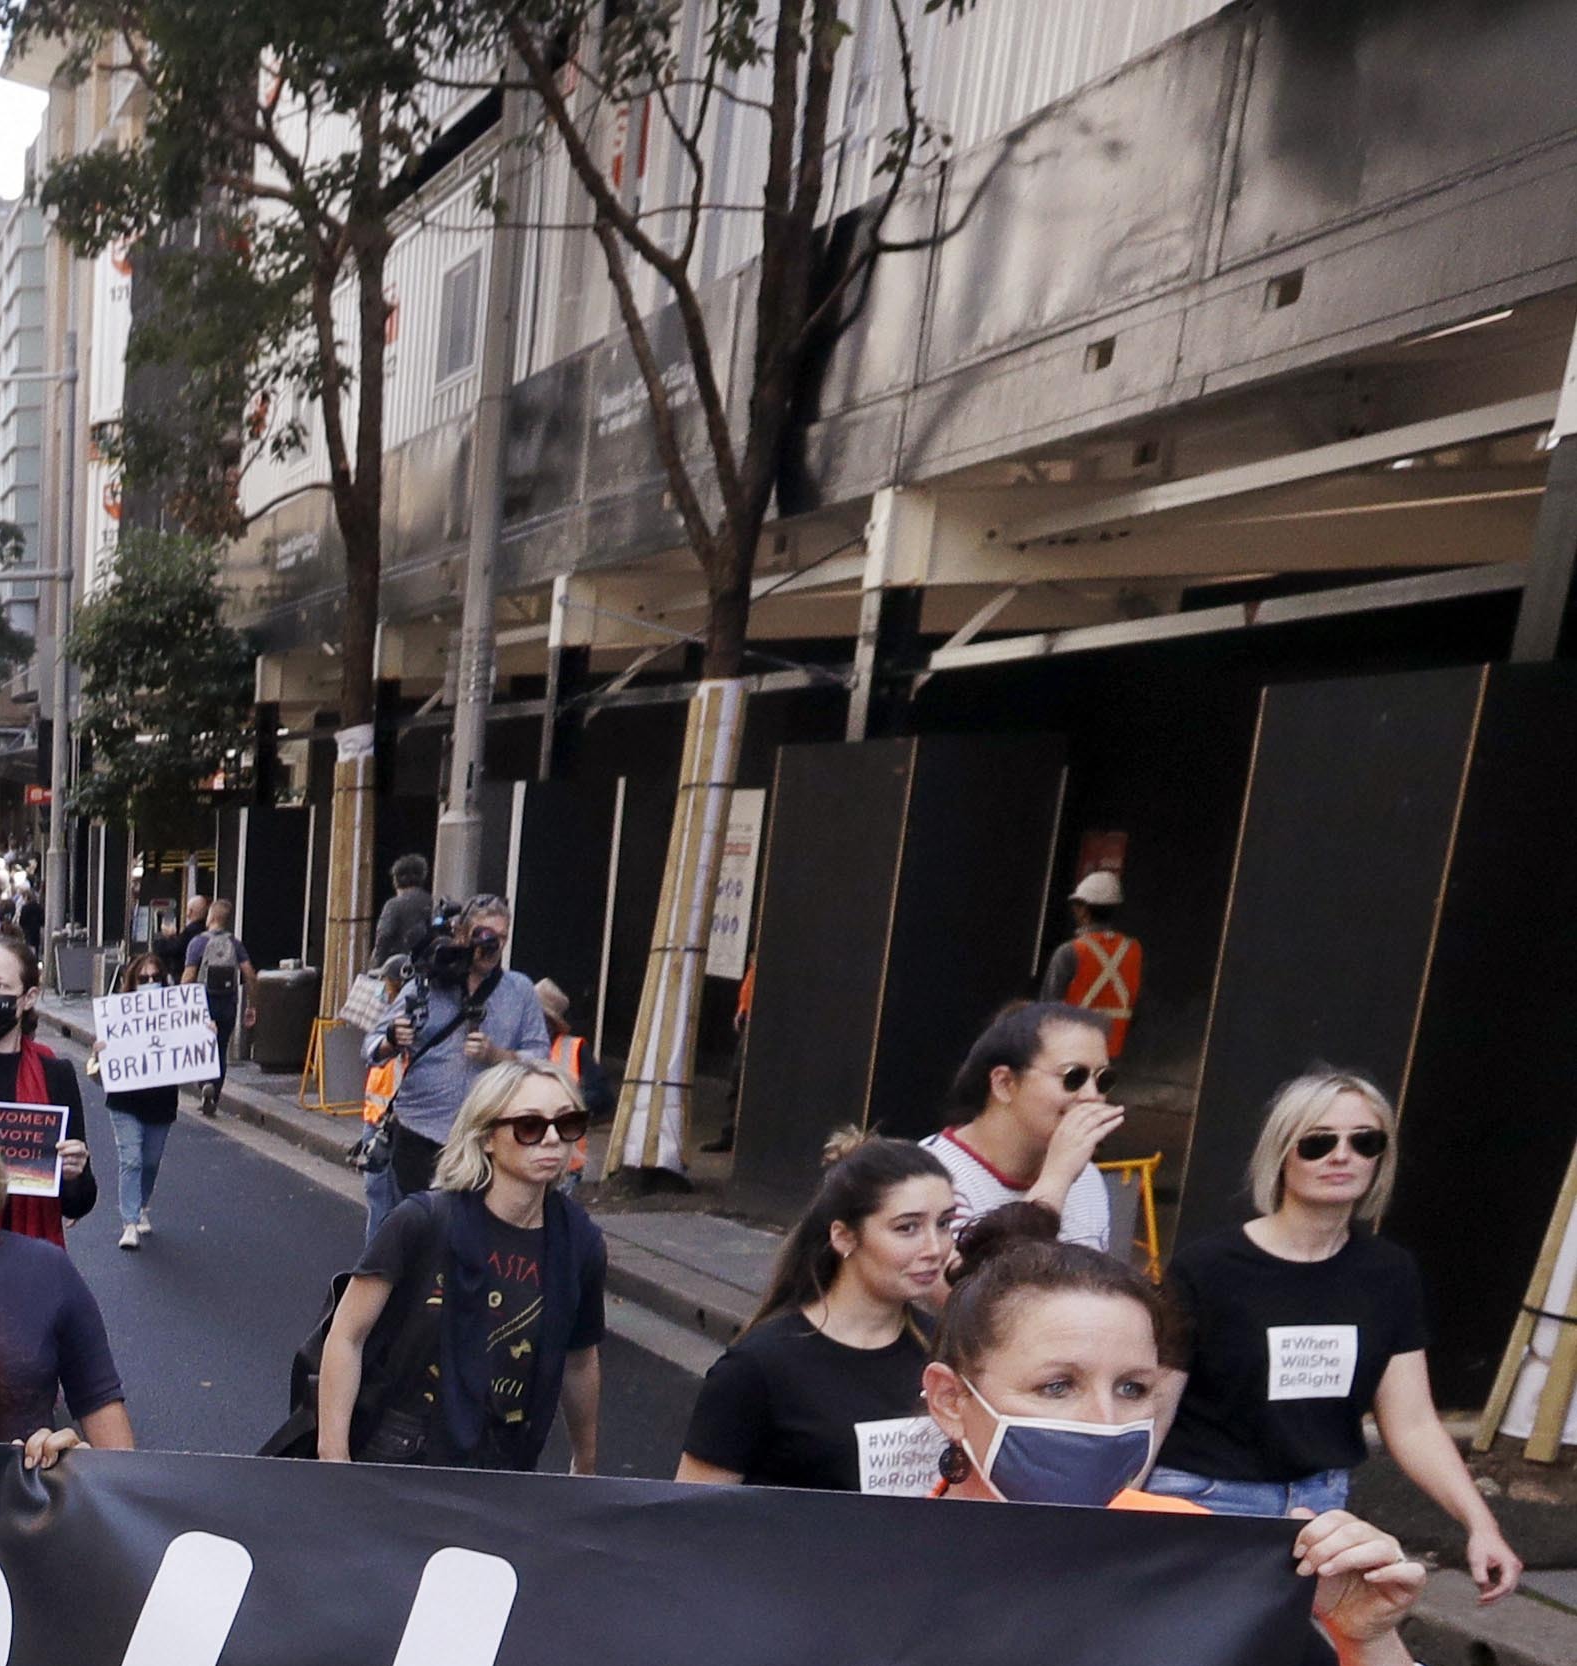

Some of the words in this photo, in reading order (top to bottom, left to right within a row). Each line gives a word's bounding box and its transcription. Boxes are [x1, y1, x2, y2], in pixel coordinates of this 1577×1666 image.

[101, 1000, 108, 1018] I
[120, 986, 203, 1015] BELIEVE
[107, 1008, 210, 1039] KATHERINE
[108, 1038, 217, 1081] BRITTANY
[1281, 1336, 1340, 1351] #When
[1281, 1355, 1340, 1369] WillShe
[1279, 1372, 1341, 1388] BeRight
